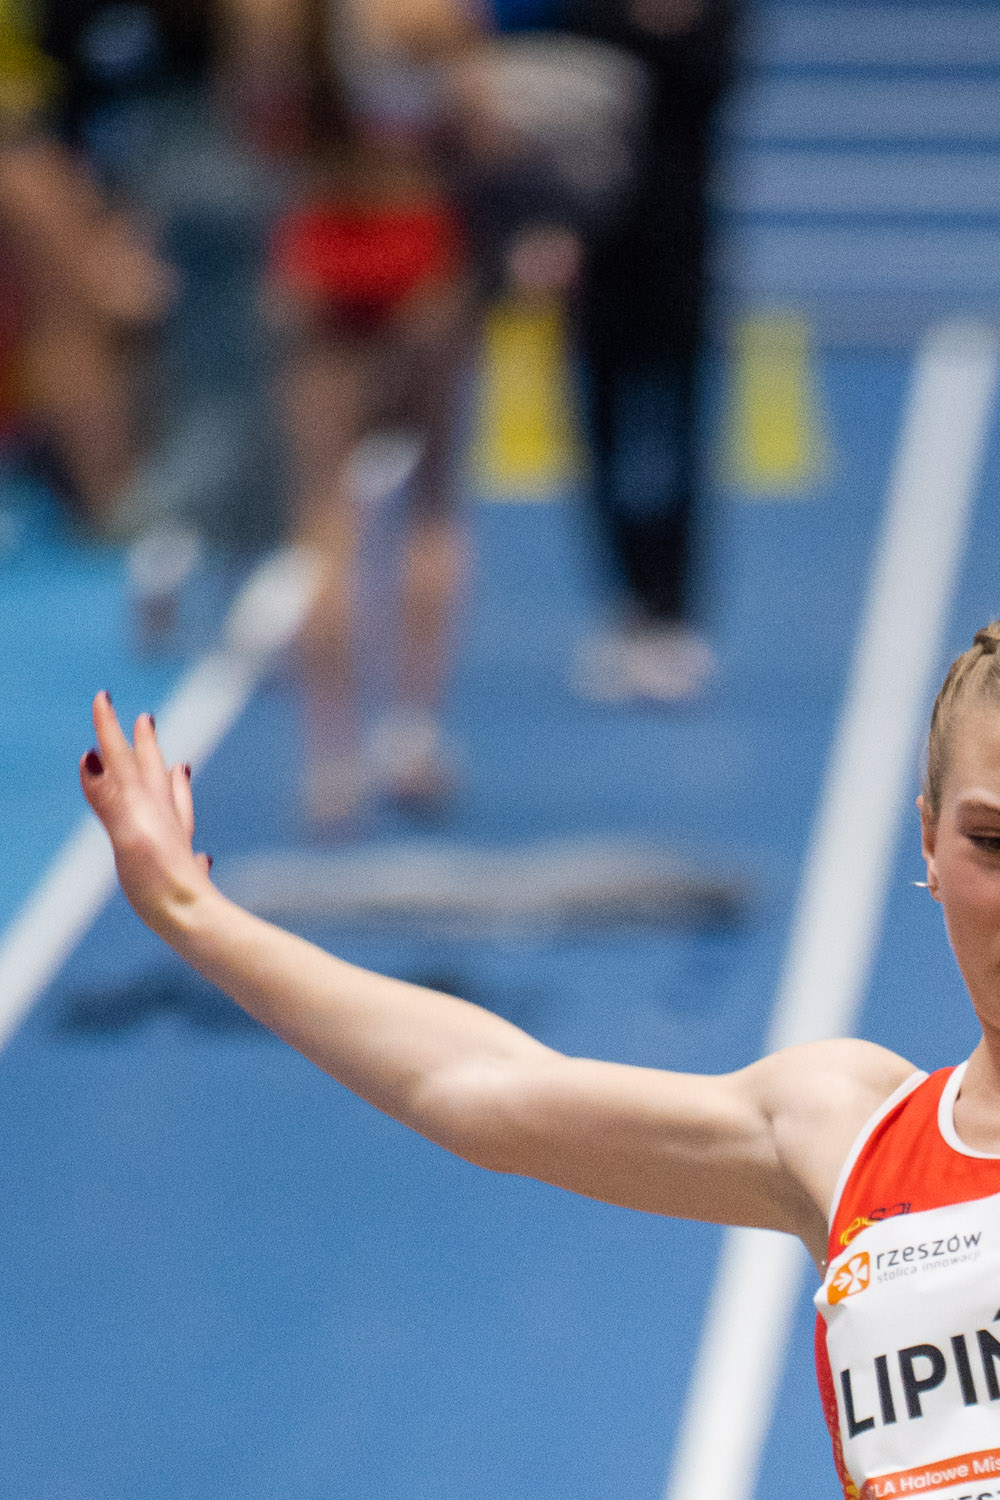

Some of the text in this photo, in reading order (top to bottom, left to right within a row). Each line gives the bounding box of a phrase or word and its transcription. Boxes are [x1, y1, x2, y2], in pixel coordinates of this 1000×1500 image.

[876, 1231, 982, 1270] rzeszów
[876, 1250, 982, 1284] stolica innowacji
[900, 1464, 969, 1492] Halowe
